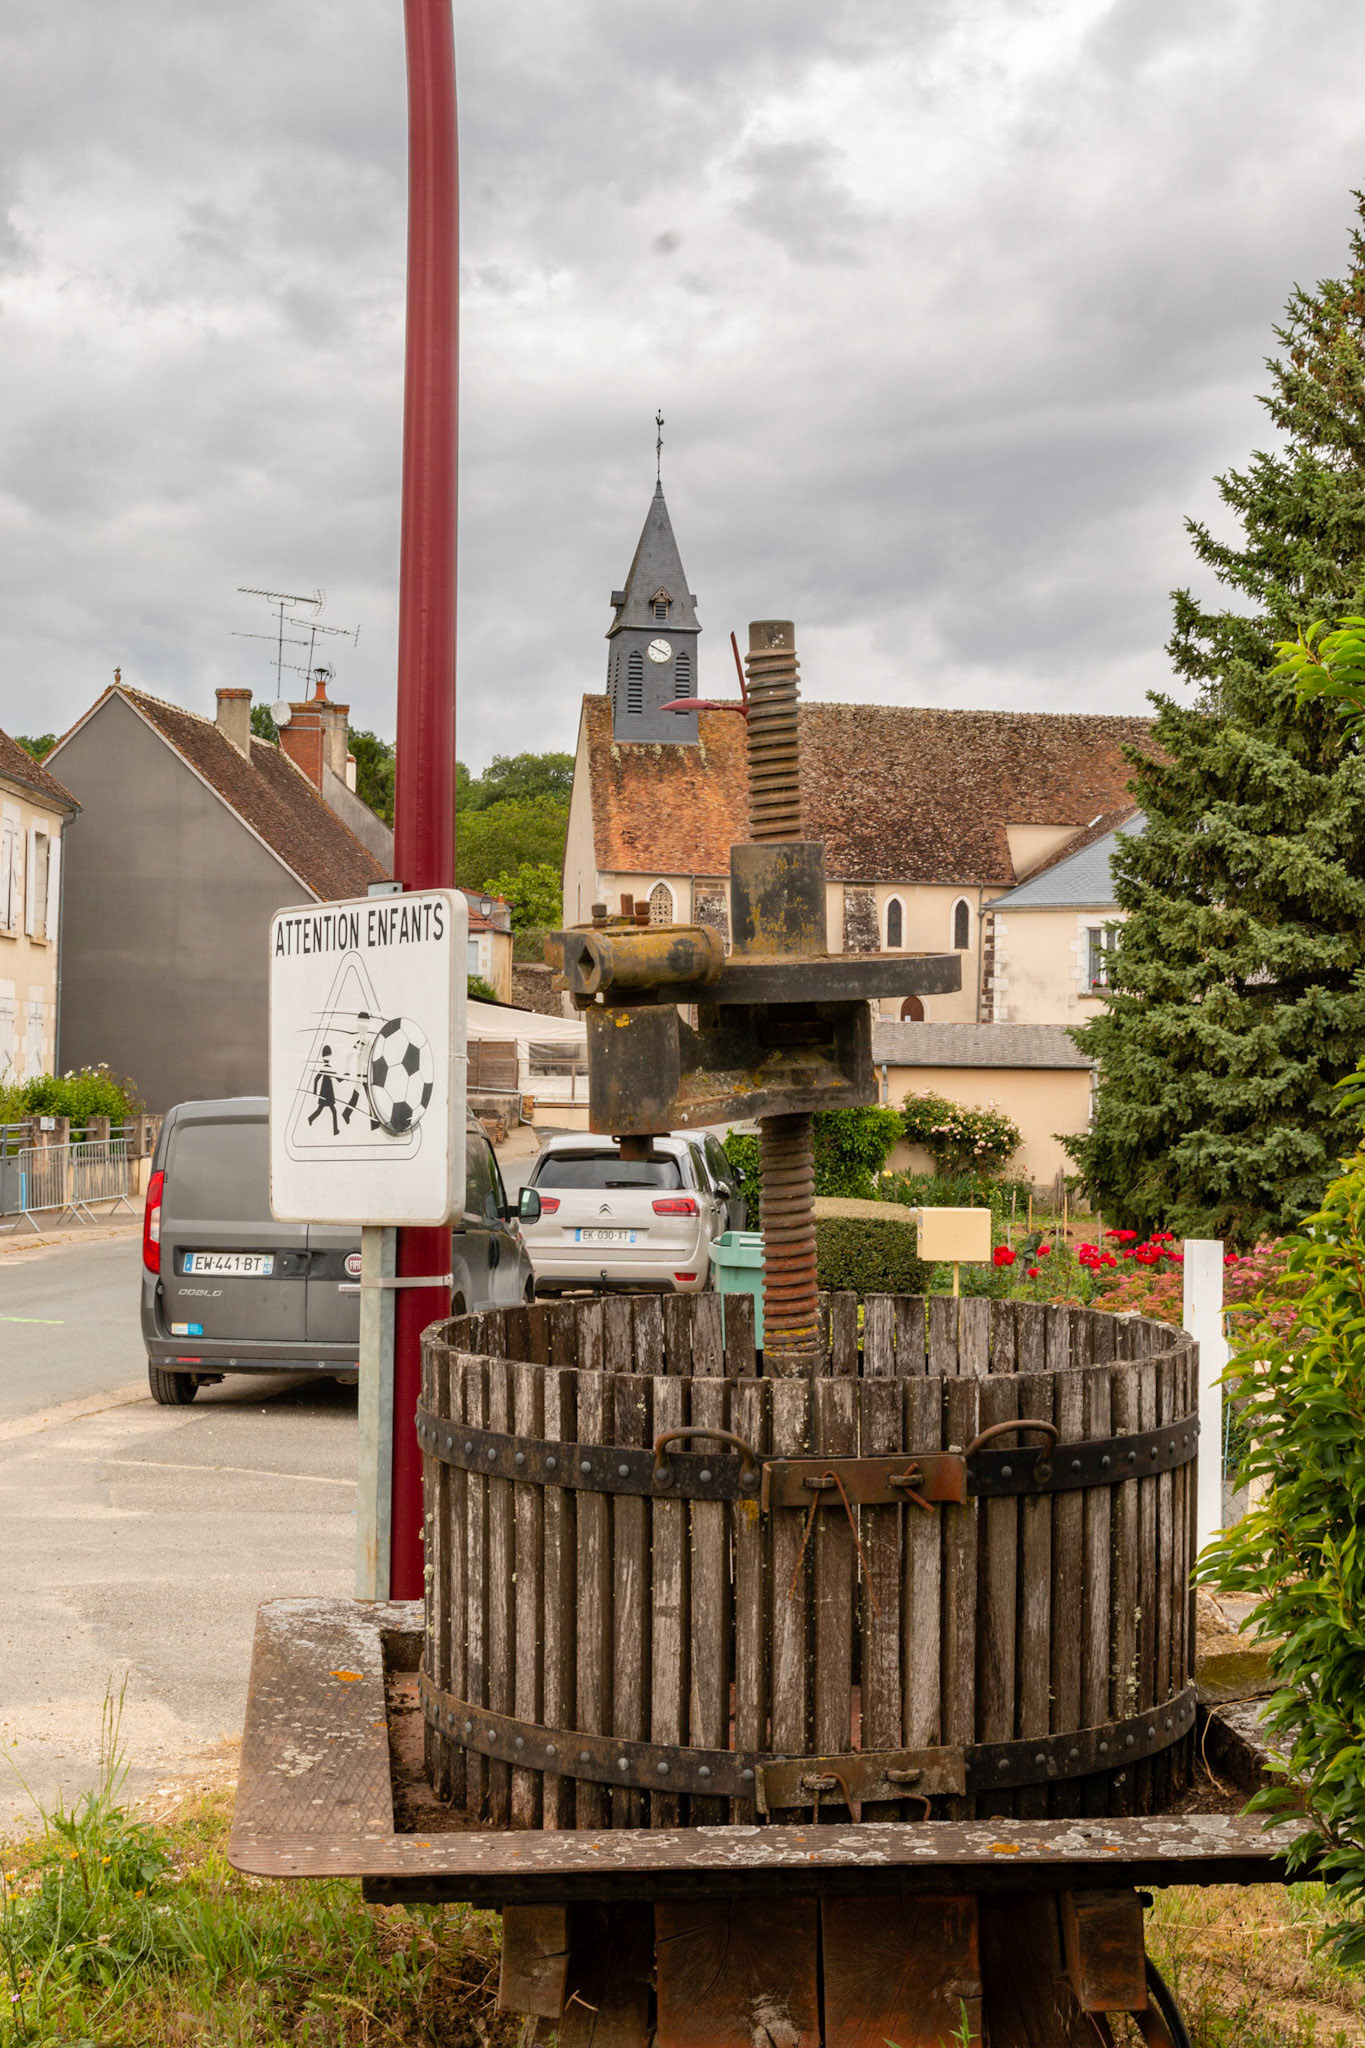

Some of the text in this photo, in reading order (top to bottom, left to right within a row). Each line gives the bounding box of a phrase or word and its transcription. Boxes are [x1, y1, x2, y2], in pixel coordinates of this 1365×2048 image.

[275, 902, 444, 957] ATTENTION ENFANTS
[195, 1256, 262, 1271] EW-441-BT
